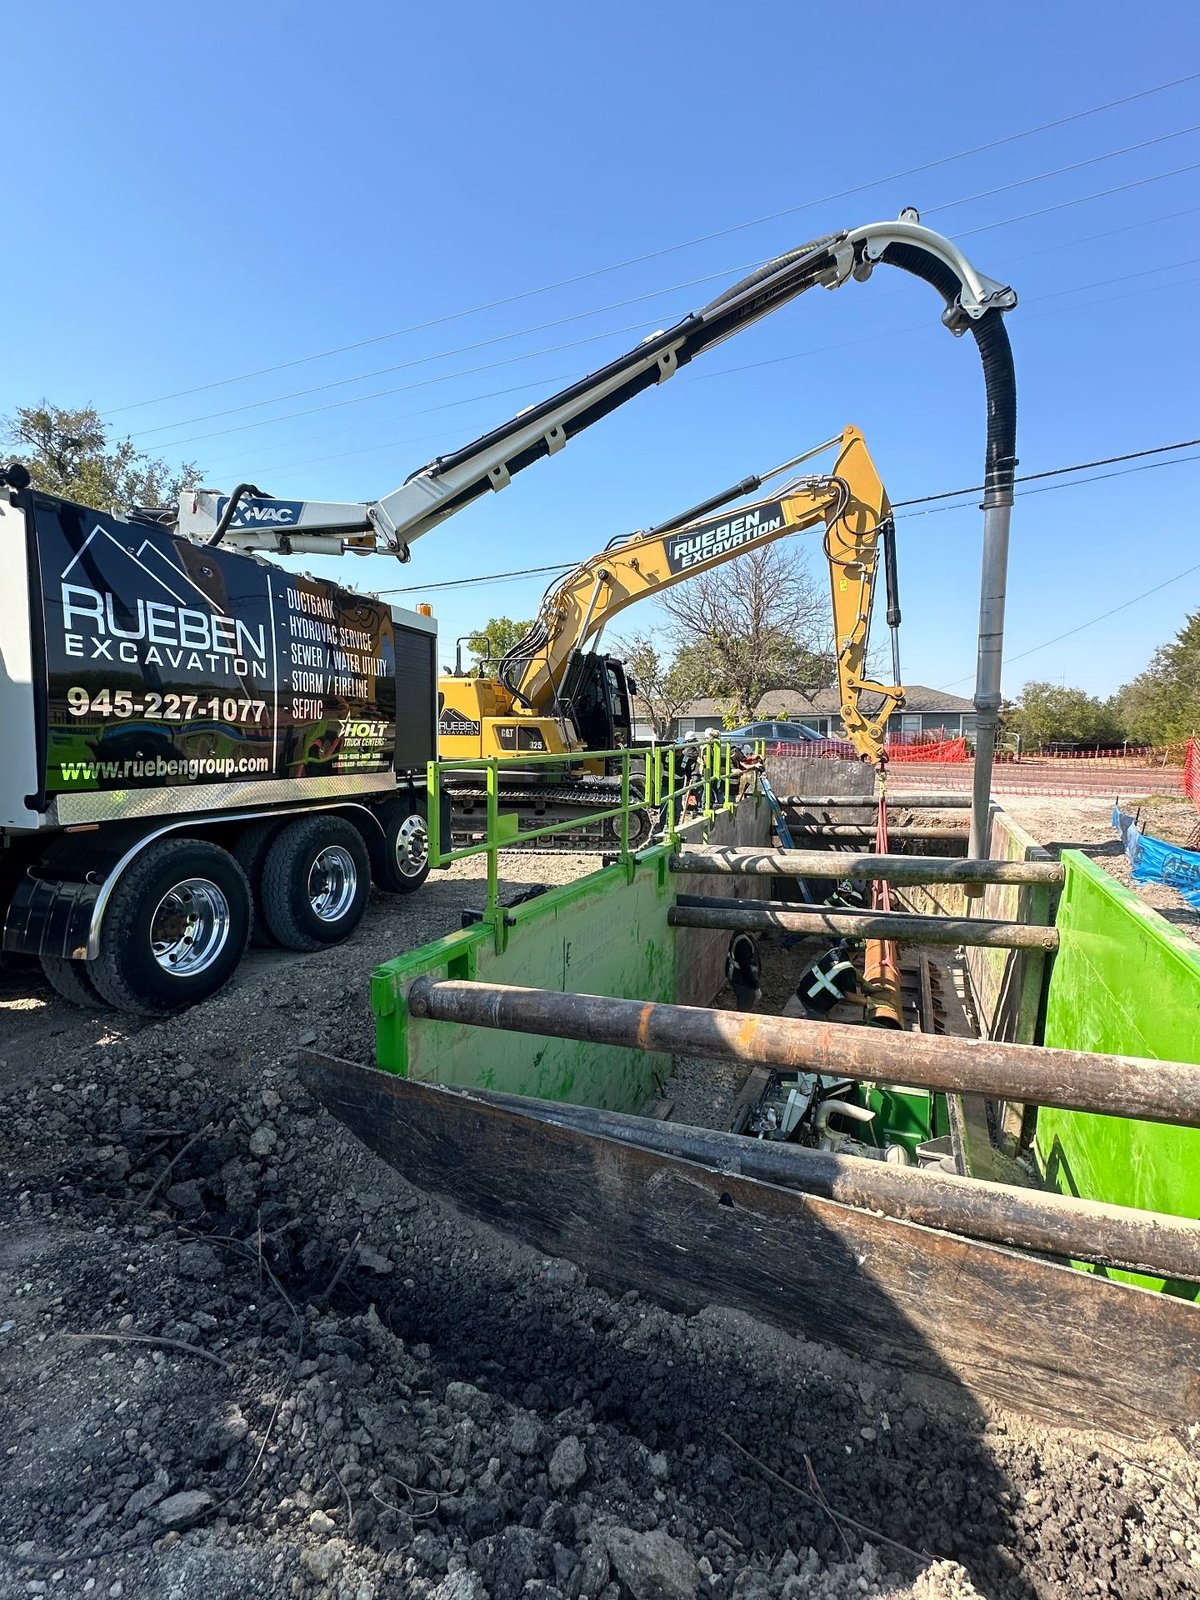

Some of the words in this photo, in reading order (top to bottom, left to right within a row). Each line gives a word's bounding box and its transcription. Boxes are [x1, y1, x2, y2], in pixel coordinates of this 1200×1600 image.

[674, 510, 760, 560] RUEBEN
[681, 517, 780, 568] EXCAVATION
[286, 587, 335, 620] DUCTBANK
[61, 582, 266, 659] RUEBEN
[289, 615, 337, 645] HYDROVAC
[339, 627, 373, 652] SERVICE
[64, 633, 267, 679] EXCAVATION
[291, 643, 323, 668] SEWER
[333, 650, 360, 673] WATER
[362, 656, 387, 677] UTILITY
[292, 670, 323, 694] STORM
[334, 676, 369, 698] FIRELINE
[67, 687, 266, 723] 945-227-1077
[292, 698, 323, 719] SEPTIC
[344, 723, 388, 737] HOLT
[439, 721, 479, 731] RUEBEN
[501, 728, 514, 738] CAT
[344, 738, 361, 747] TRUCK
[529, 741, 543, 750] 325
[60, 755, 269, 781] www.ruebengroup.com
